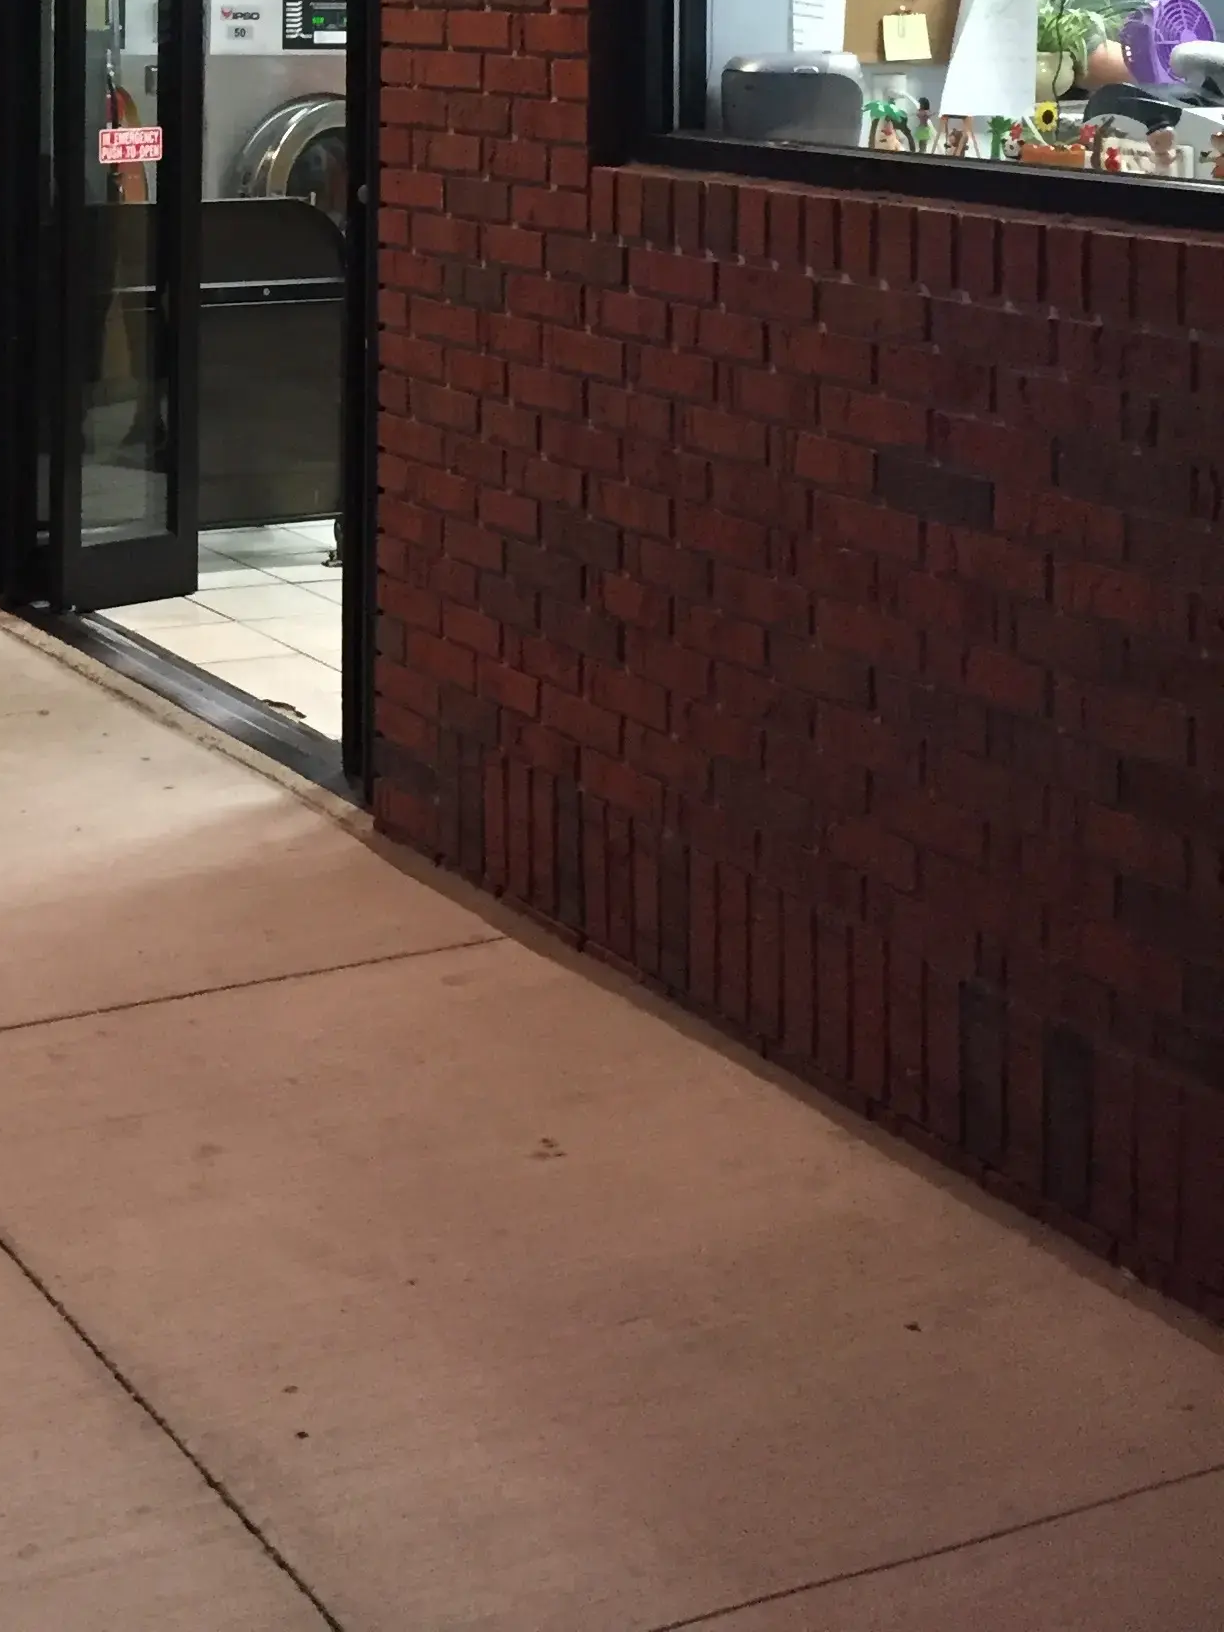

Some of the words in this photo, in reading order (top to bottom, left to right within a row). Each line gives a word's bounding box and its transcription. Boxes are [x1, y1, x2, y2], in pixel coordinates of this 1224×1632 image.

[232, 11, 260, 21] IPSO
[234, 27, 246, 38] 50
[114, 130, 159, 144] EMERGENCY
[139, 144, 160, 157] OPEN
